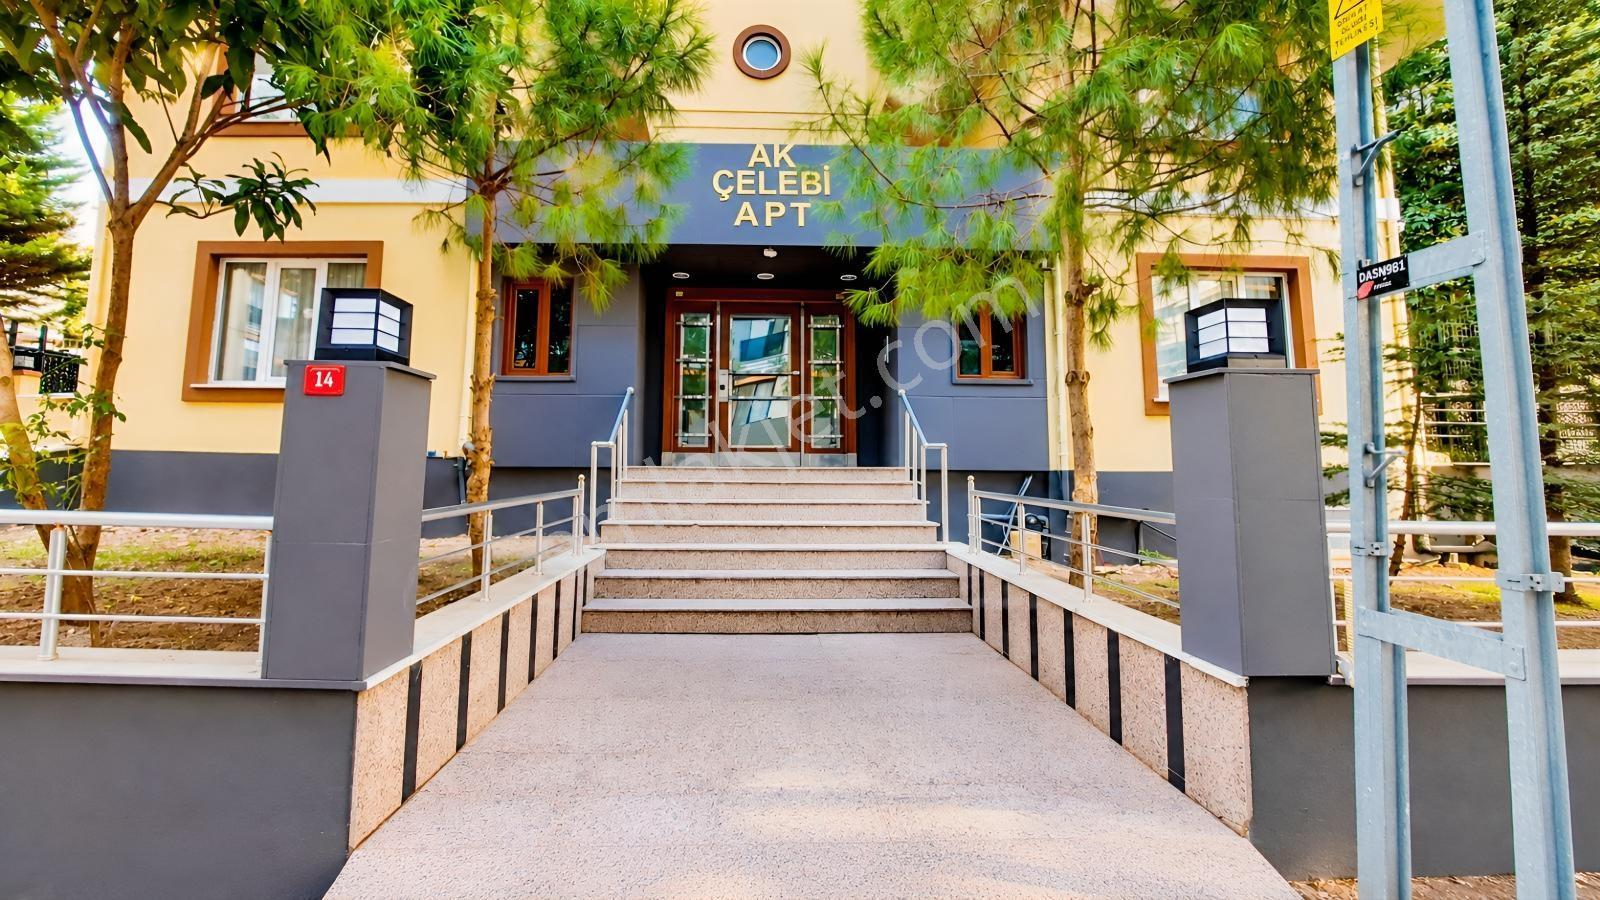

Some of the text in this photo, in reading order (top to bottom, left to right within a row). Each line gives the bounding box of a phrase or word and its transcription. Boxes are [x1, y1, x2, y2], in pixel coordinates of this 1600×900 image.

[748, 144, 796, 168] AK
[712, 165, 831, 201] ÇELEBİ
[733, 202, 811, 227] APT
[1359, 260, 1406, 283] DASN981
[315, 371, 333, 388] 14
